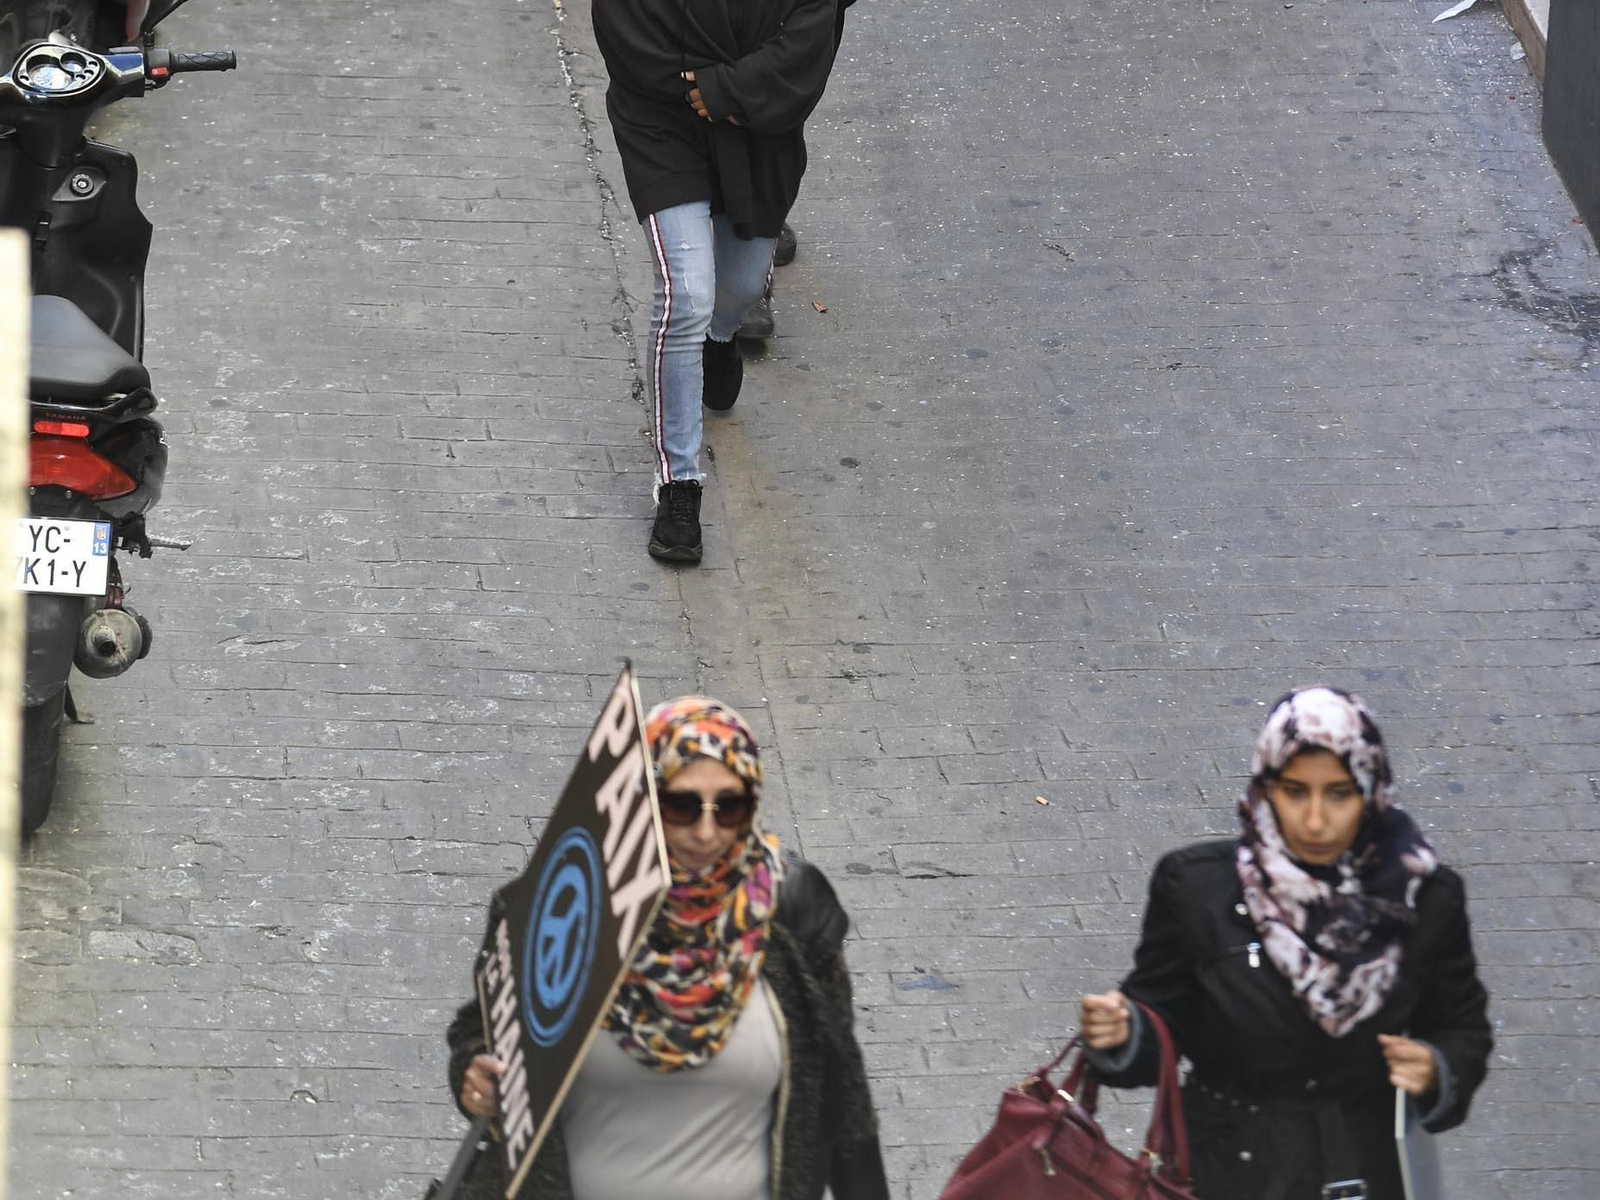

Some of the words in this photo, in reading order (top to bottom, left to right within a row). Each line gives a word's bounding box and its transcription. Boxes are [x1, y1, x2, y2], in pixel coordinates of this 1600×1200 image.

[29, 524, 71, 553] YC-
[93, 542, 108, 554] 13
[588, 669, 664, 962] PAIX
[491, 974, 534, 1171] HAINE
